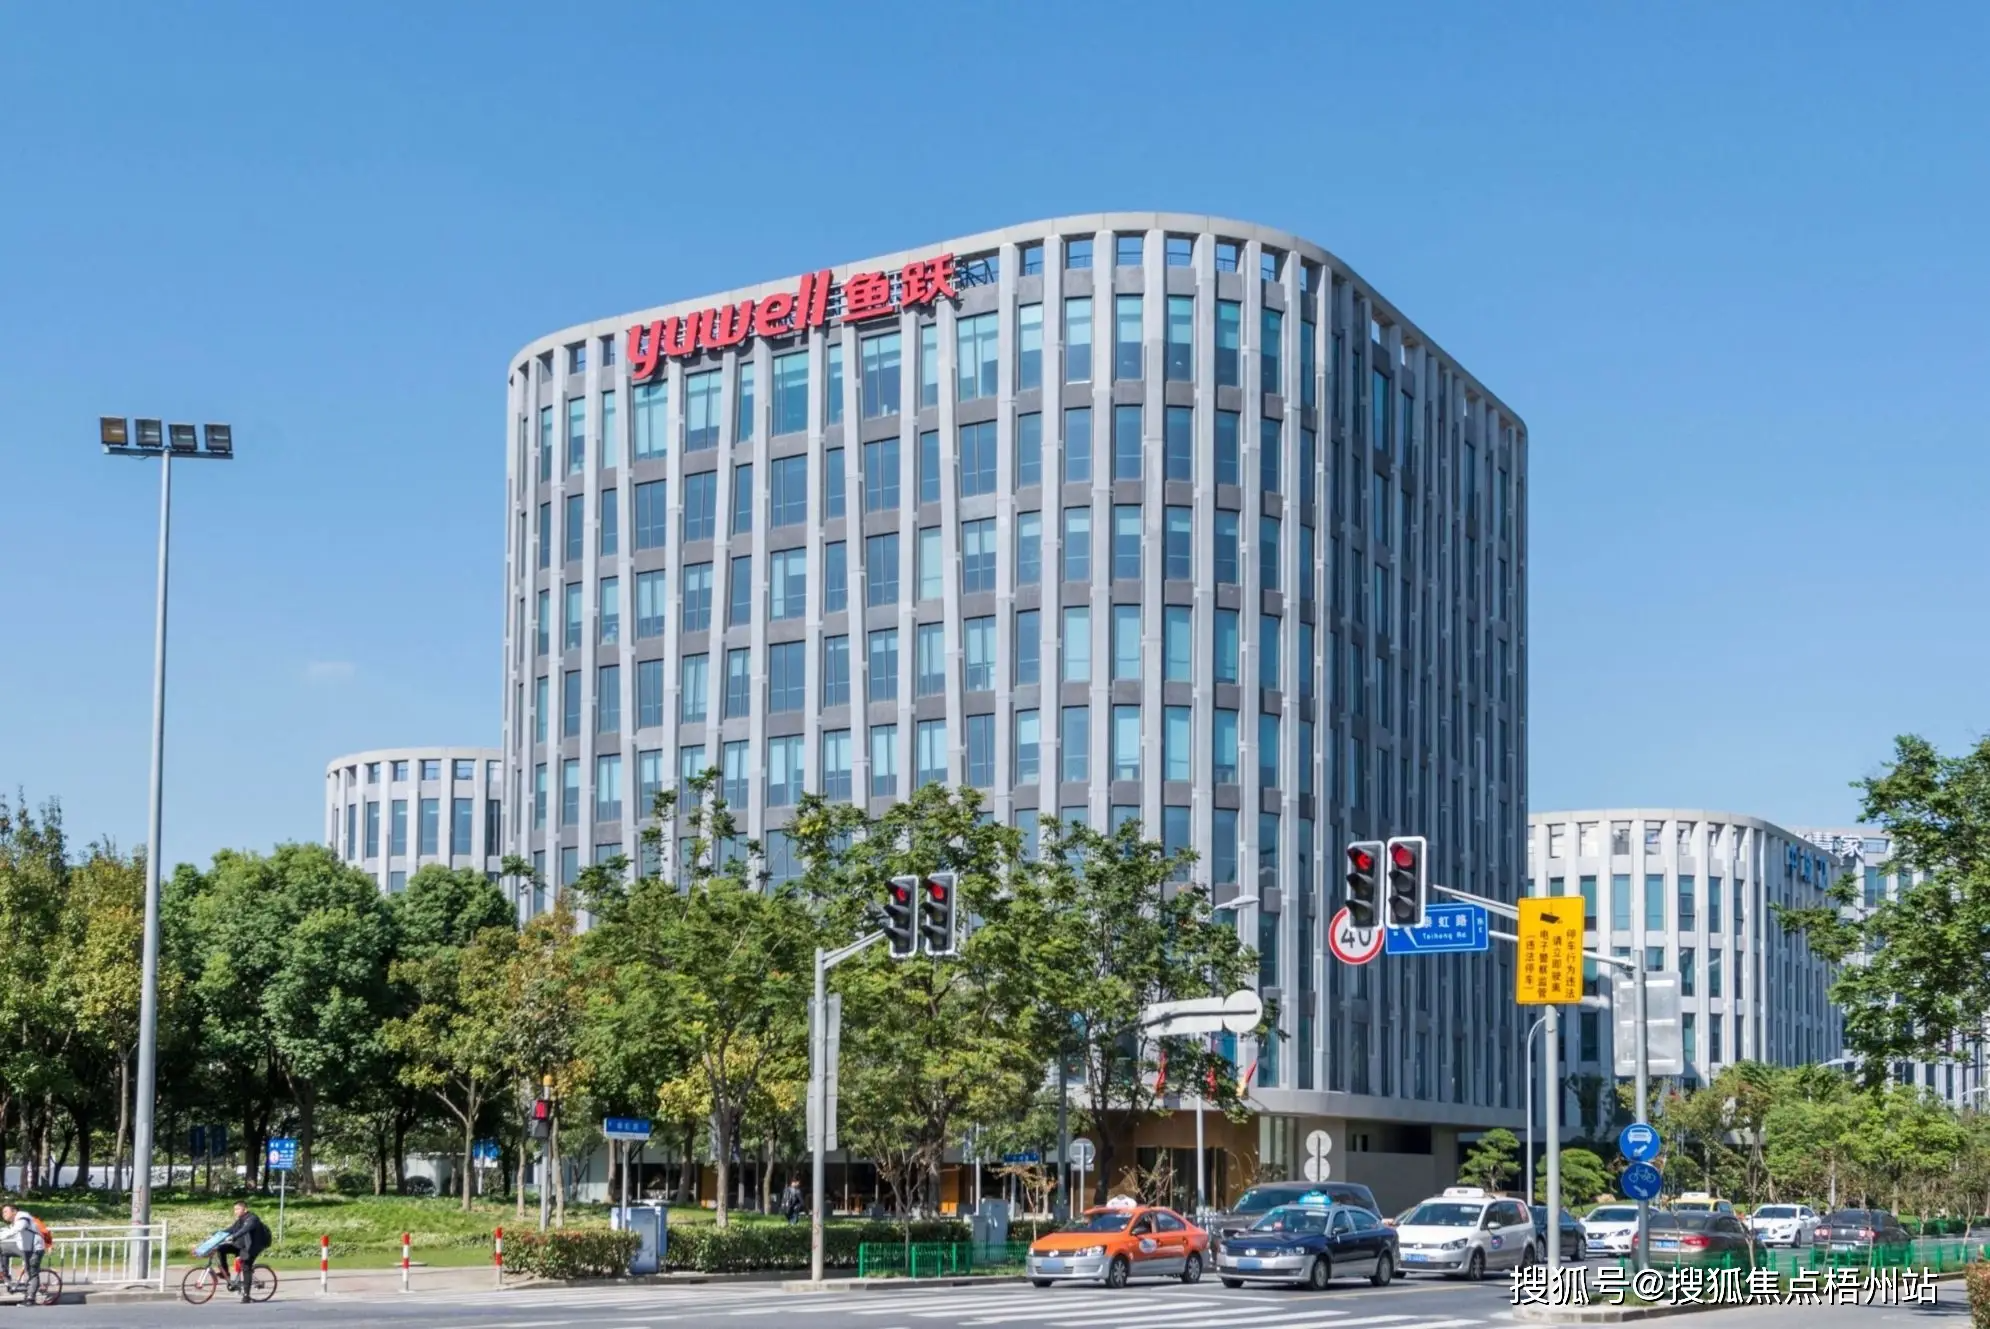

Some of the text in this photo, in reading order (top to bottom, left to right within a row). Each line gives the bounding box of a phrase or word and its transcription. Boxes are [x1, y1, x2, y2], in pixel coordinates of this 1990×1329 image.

[627, 252, 957, 380] yuwell 鱼跃
[1565, 928, 1576, 998] 停车行为违法
